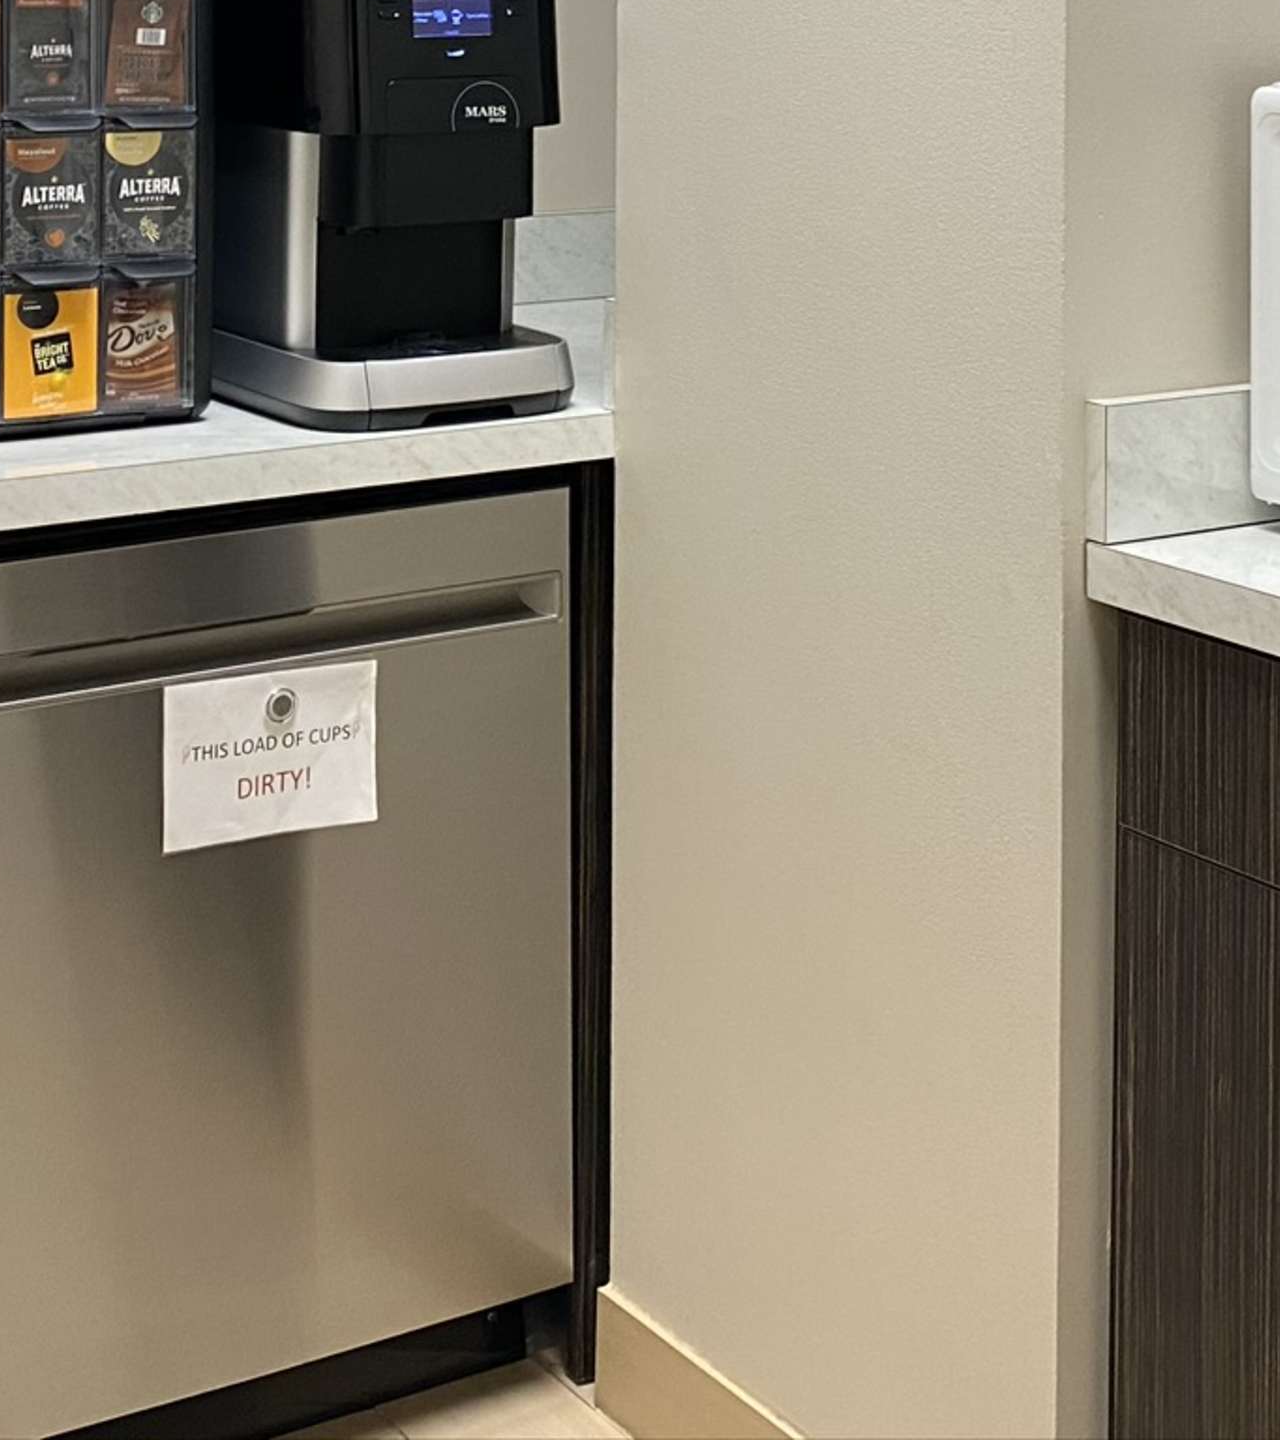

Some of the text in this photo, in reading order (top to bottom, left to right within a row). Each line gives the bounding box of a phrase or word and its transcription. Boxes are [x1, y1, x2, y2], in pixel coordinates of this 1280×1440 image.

[464, 105, 507, 118] MARS
[21, 183, 86, 208] ALTERRA
[119, 175, 181, 200] ALTERRA
[37, 357, 57, 371] TEA
[191, 723, 352, 763] THIS LOAD OF CUPS
[237, 765, 313, 800] DIRTY!
